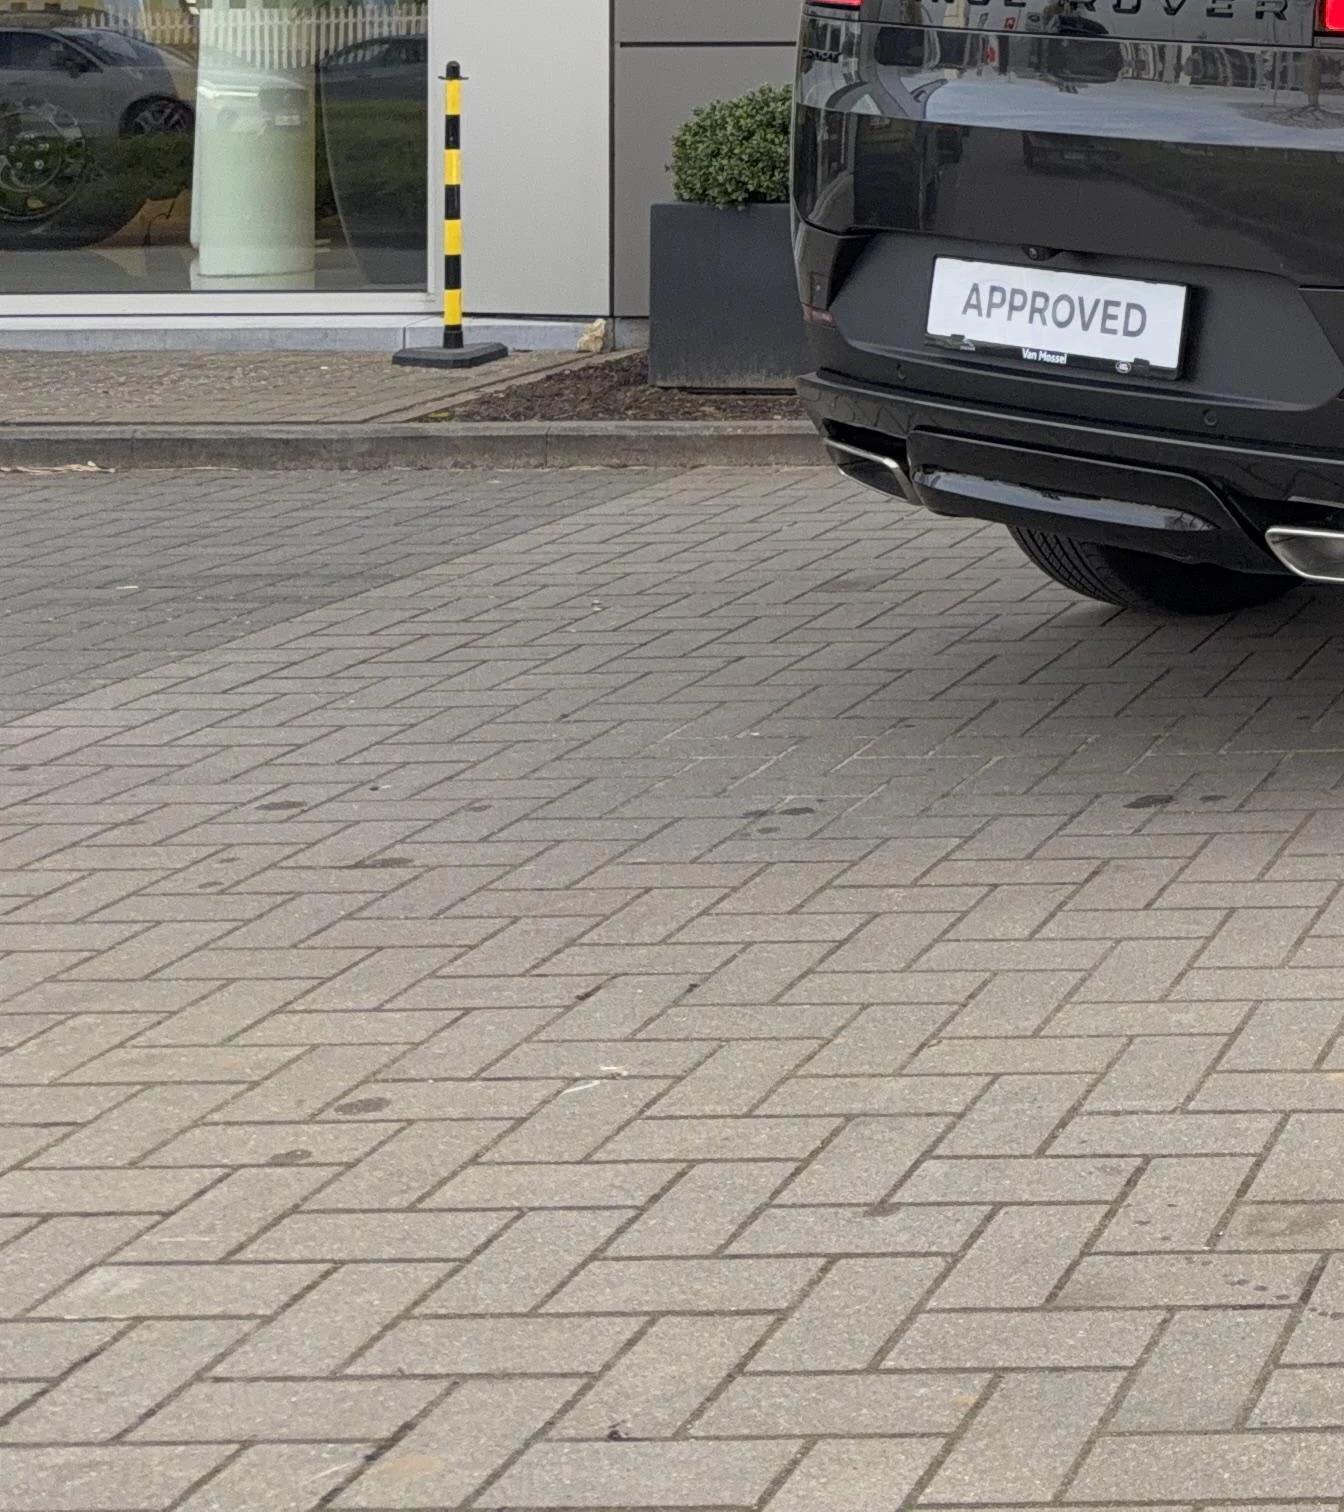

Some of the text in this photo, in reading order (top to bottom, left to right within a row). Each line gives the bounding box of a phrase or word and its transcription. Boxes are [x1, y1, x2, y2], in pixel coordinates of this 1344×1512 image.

[961, 282, 1148, 338] APPROVED
[1021, 347, 1068, 365] Van Mossel
